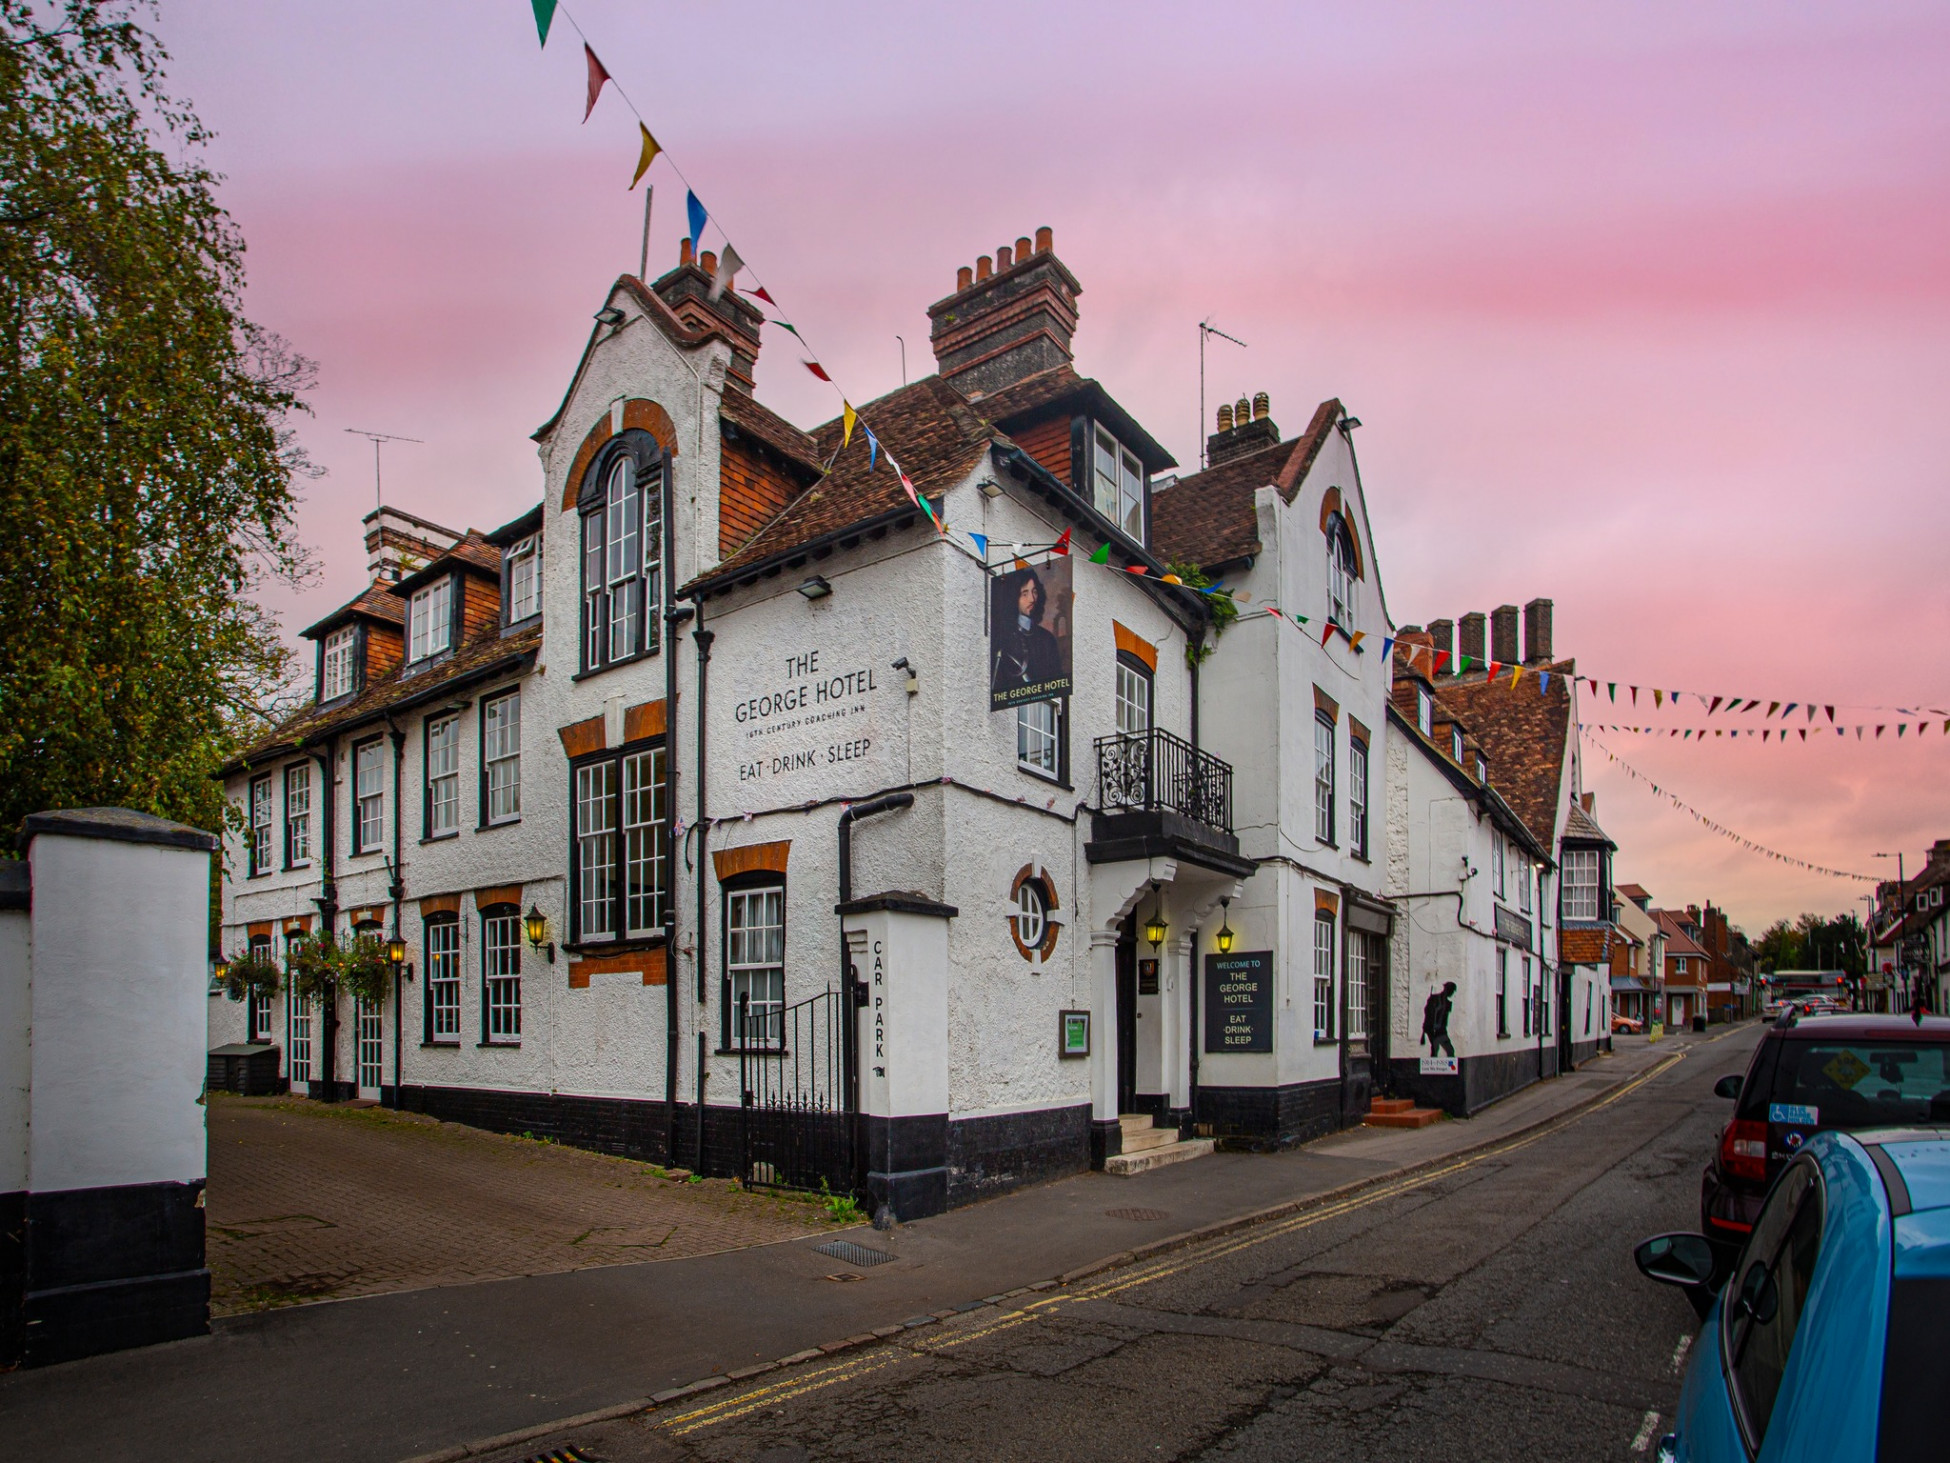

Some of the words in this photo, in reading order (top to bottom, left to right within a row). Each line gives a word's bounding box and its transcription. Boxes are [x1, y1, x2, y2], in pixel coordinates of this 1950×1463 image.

[786, 650, 819, 678] THE
[735, 686, 808, 723] GEORGE
[817, 669, 877, 703] HOTEL
[993, 691, 1007, 702] THE
[1009, 683, 1042, 698] GEORGE
[1044, 678, 1070, 691] HOTEL
[766, 719, 801, 735] CENTURY
[805, 708, 846, 726] COACHING
[850, 704, 865, 715] INN
[740, 761, 763, 781] EAT
[772, 749, 816, 774] DRINK
[827, 738, 871, 763] SLEEP
[873, 940, 883, 986] CAR
[1216, 960, 1250, 970] WELCOME
[1251, 960, 1261, 968] TO
[1220, 983, 1258, 992] GEORGE
[1230, 971, 1247, 981] THE
[1224, 995, 1253, 1003] HOTEL
[875, 997, 884, 1057] PARK
[1230, 1015, 1246, 1024] EAT
[1225, 1036, 1252, 1045] SLEEP
